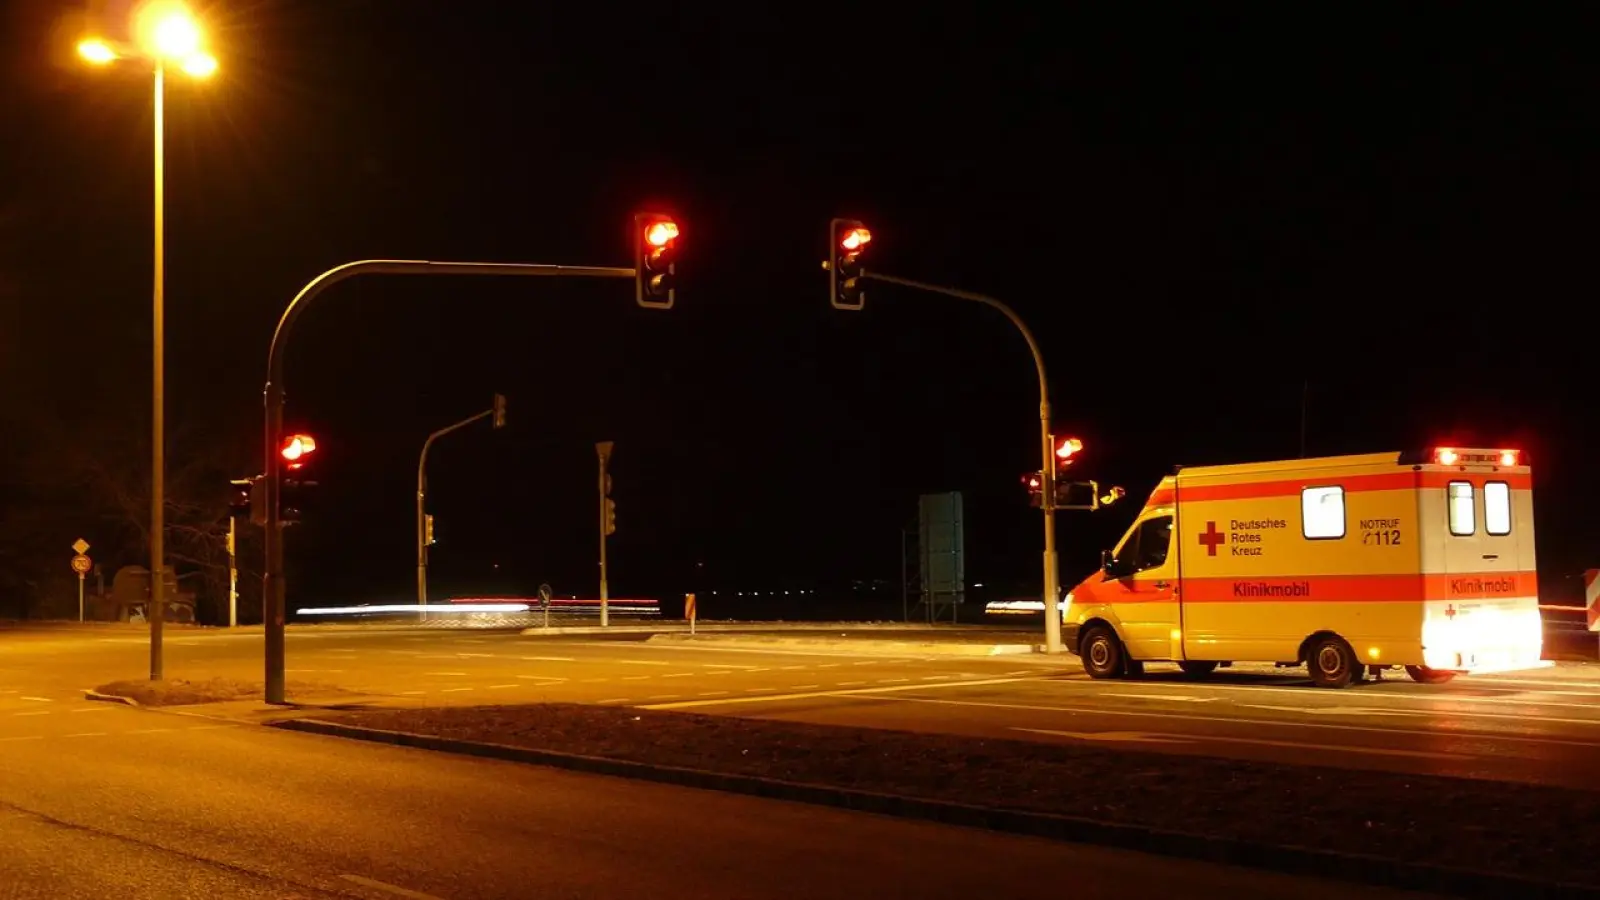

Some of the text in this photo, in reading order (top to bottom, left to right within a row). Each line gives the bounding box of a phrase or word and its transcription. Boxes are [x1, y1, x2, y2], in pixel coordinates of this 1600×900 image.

[1231, 518, 1286, 530] Deutsches
[1360, 519, 1400, 529] NOTRUF
[1231, 533, 1261, 543] Rotes
[1375, 530, 1401, 545] 112
[1232, 546, 1262, 556] Kreuz
[1233, 581, 1310, 597] Klinikmobil
[1451, 577, 1516, 594] Klinikmobil
